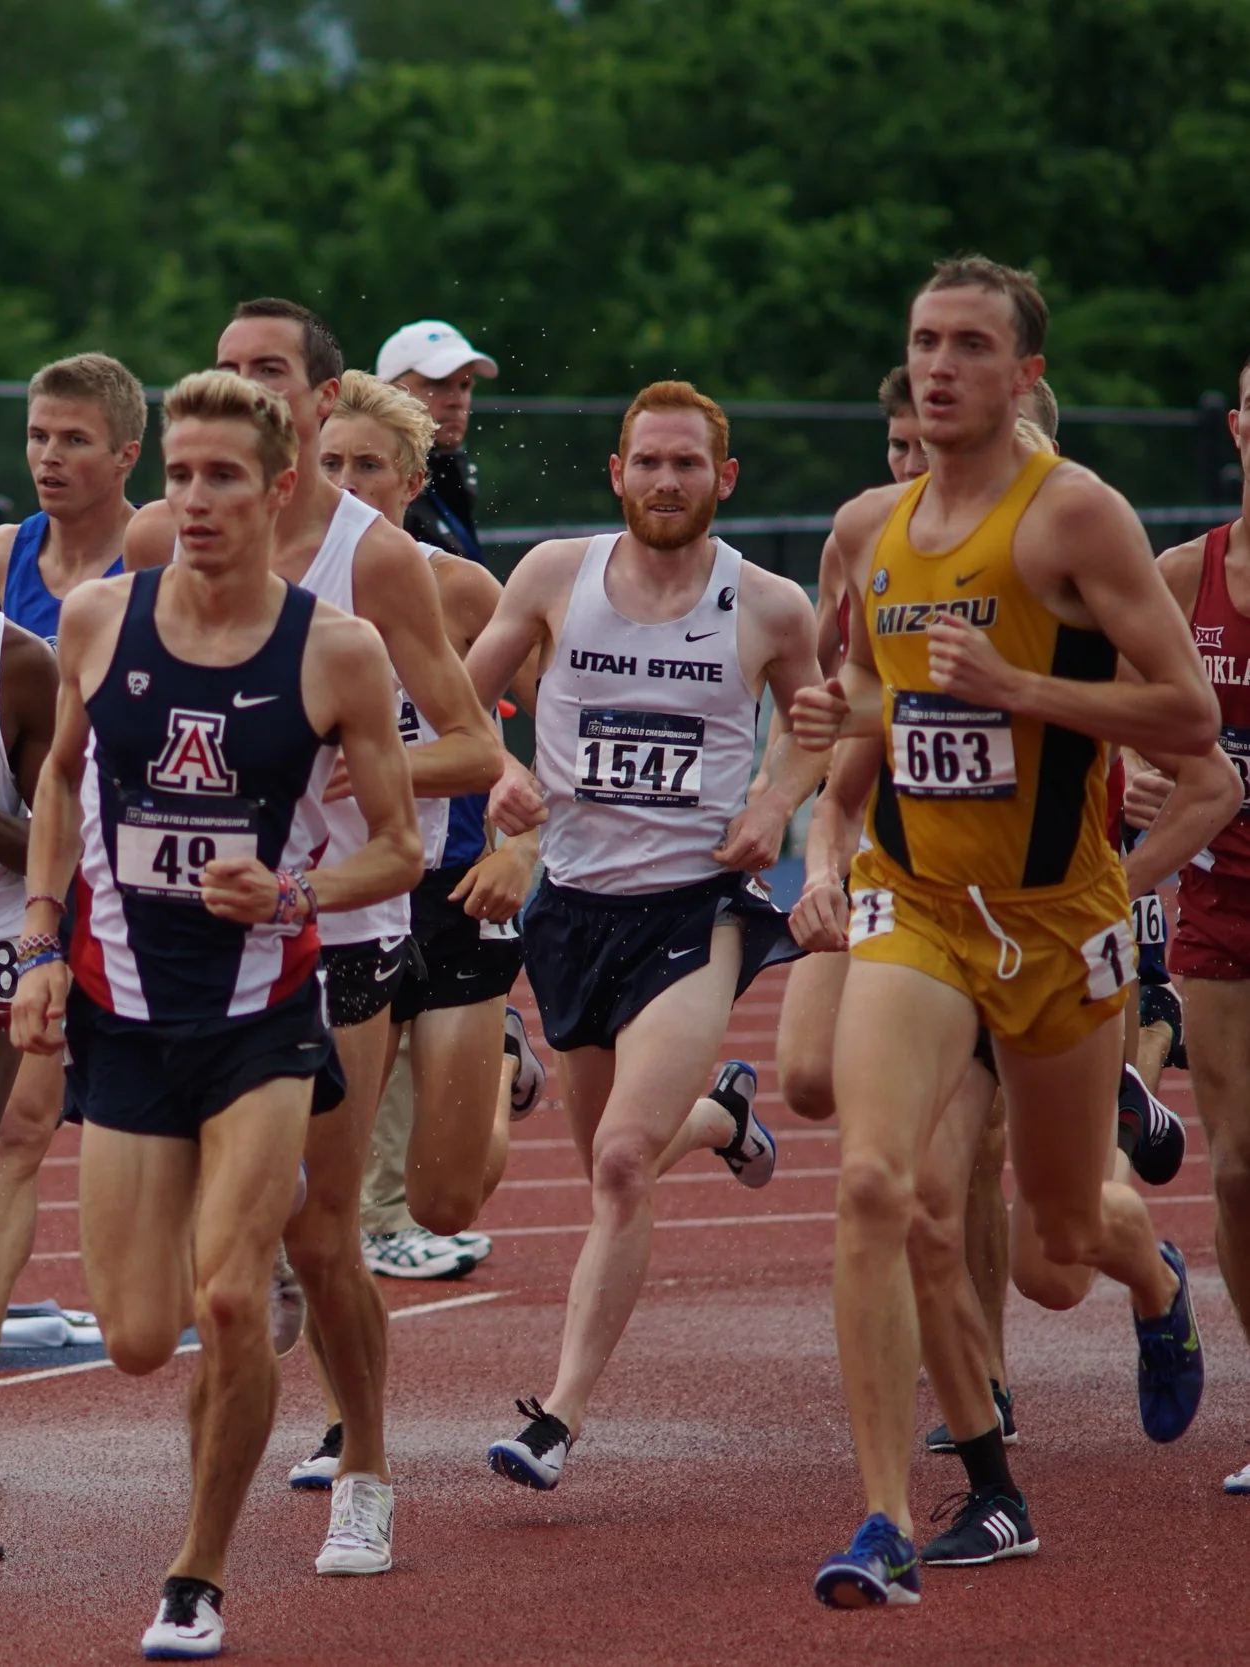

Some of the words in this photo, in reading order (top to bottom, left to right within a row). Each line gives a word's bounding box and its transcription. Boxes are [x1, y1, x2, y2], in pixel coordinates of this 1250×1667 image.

[570, 649, 637, 676] UTAH
[647, 658, 723, 683] STATE
[147, 708, 237, 796] A
[601, 725, 622, 735] TRACK
[627, 727, 645, 736] FIELD
[645, 729, 698, 740] CHAMPIONSHIPS
[907, 730, 992, 784] 663
[581, 741, 698, 793] 1547
[141, 812, 162, 823] TRACK
[169, 815, 188, 825] FIELD
[189, 817, 250, 828] CHAMPIONSHIPS
[152, 834, 216, 888] 49
[1132, 899, 1159, 943] 16
[1100, 932, 1124, 988] 1
